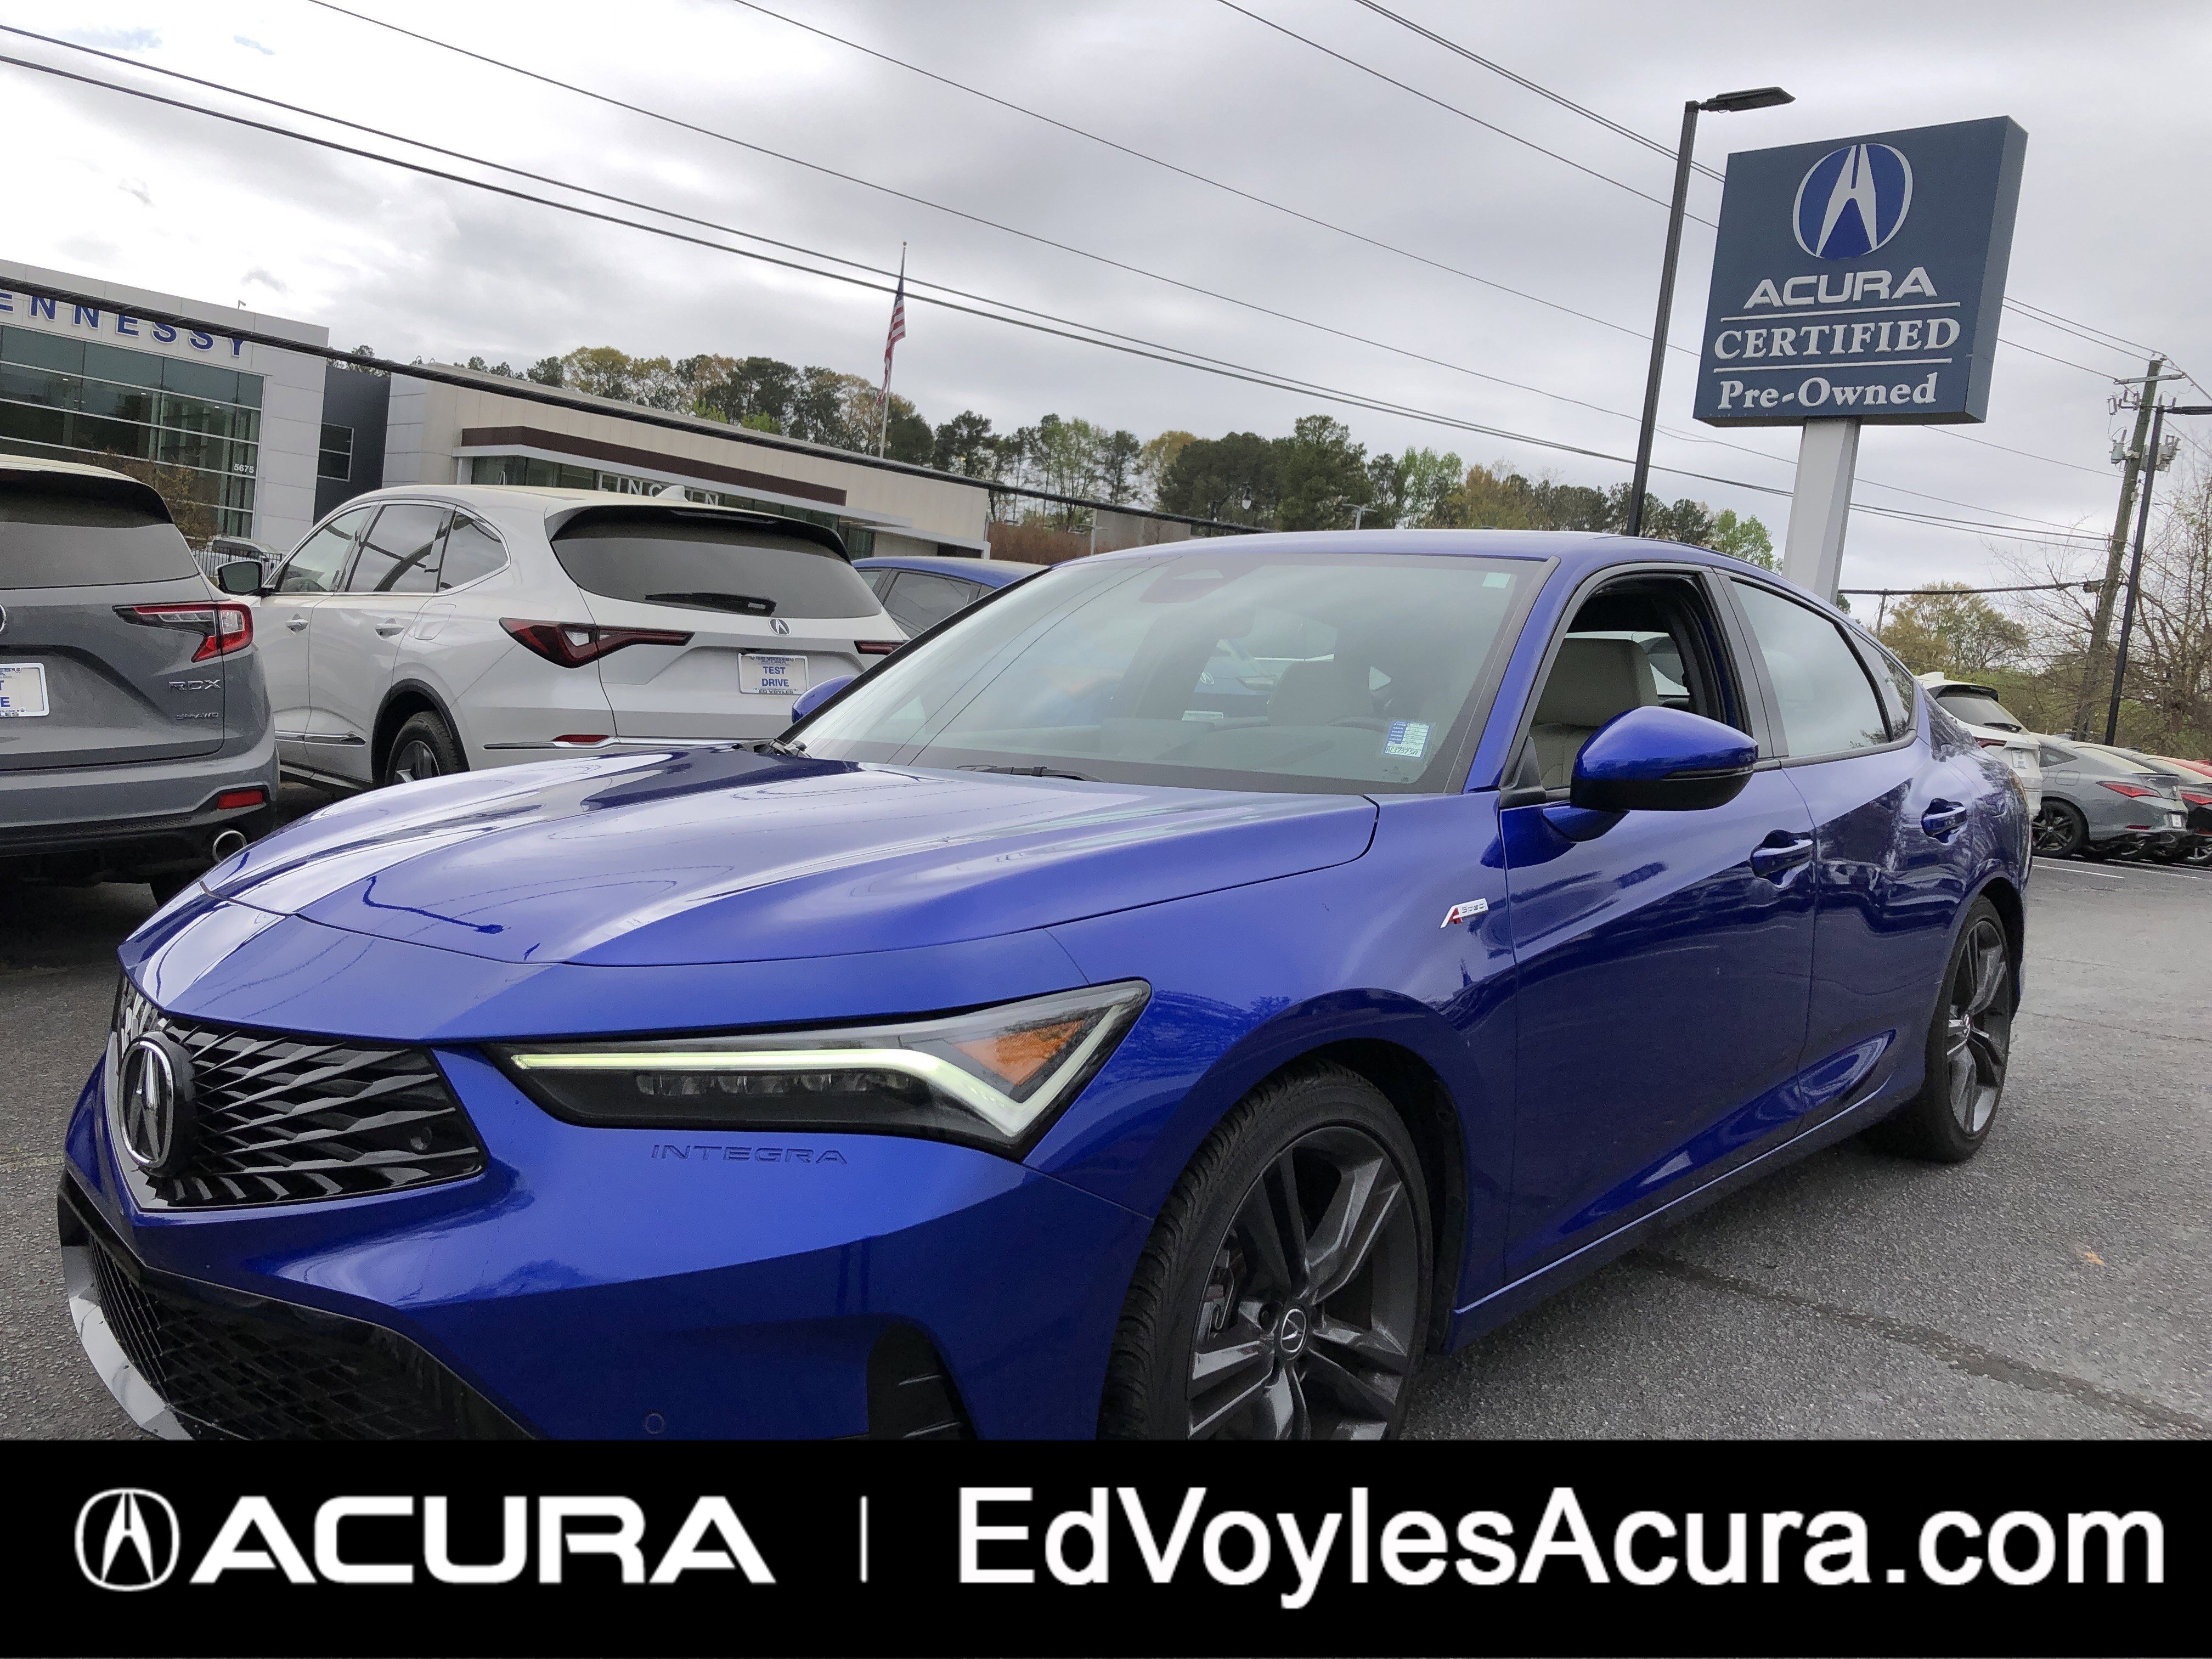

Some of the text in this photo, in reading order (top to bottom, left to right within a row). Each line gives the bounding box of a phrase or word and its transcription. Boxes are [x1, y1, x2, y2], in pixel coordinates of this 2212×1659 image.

[1743, 267, 1938, 309] ACURA
[1714, 318, 1961, 359] CERTIFIED
[1718, 371, 1938, 409] Pre-Owned
[234, 463, 254, 473] 5675
[763, 666, 786, 675] TEST
[168, 679, 221, 691] RDX
[761, 678, 789, 687] DRIVE
[651, 1144, 848, 1165] INTEGRA
